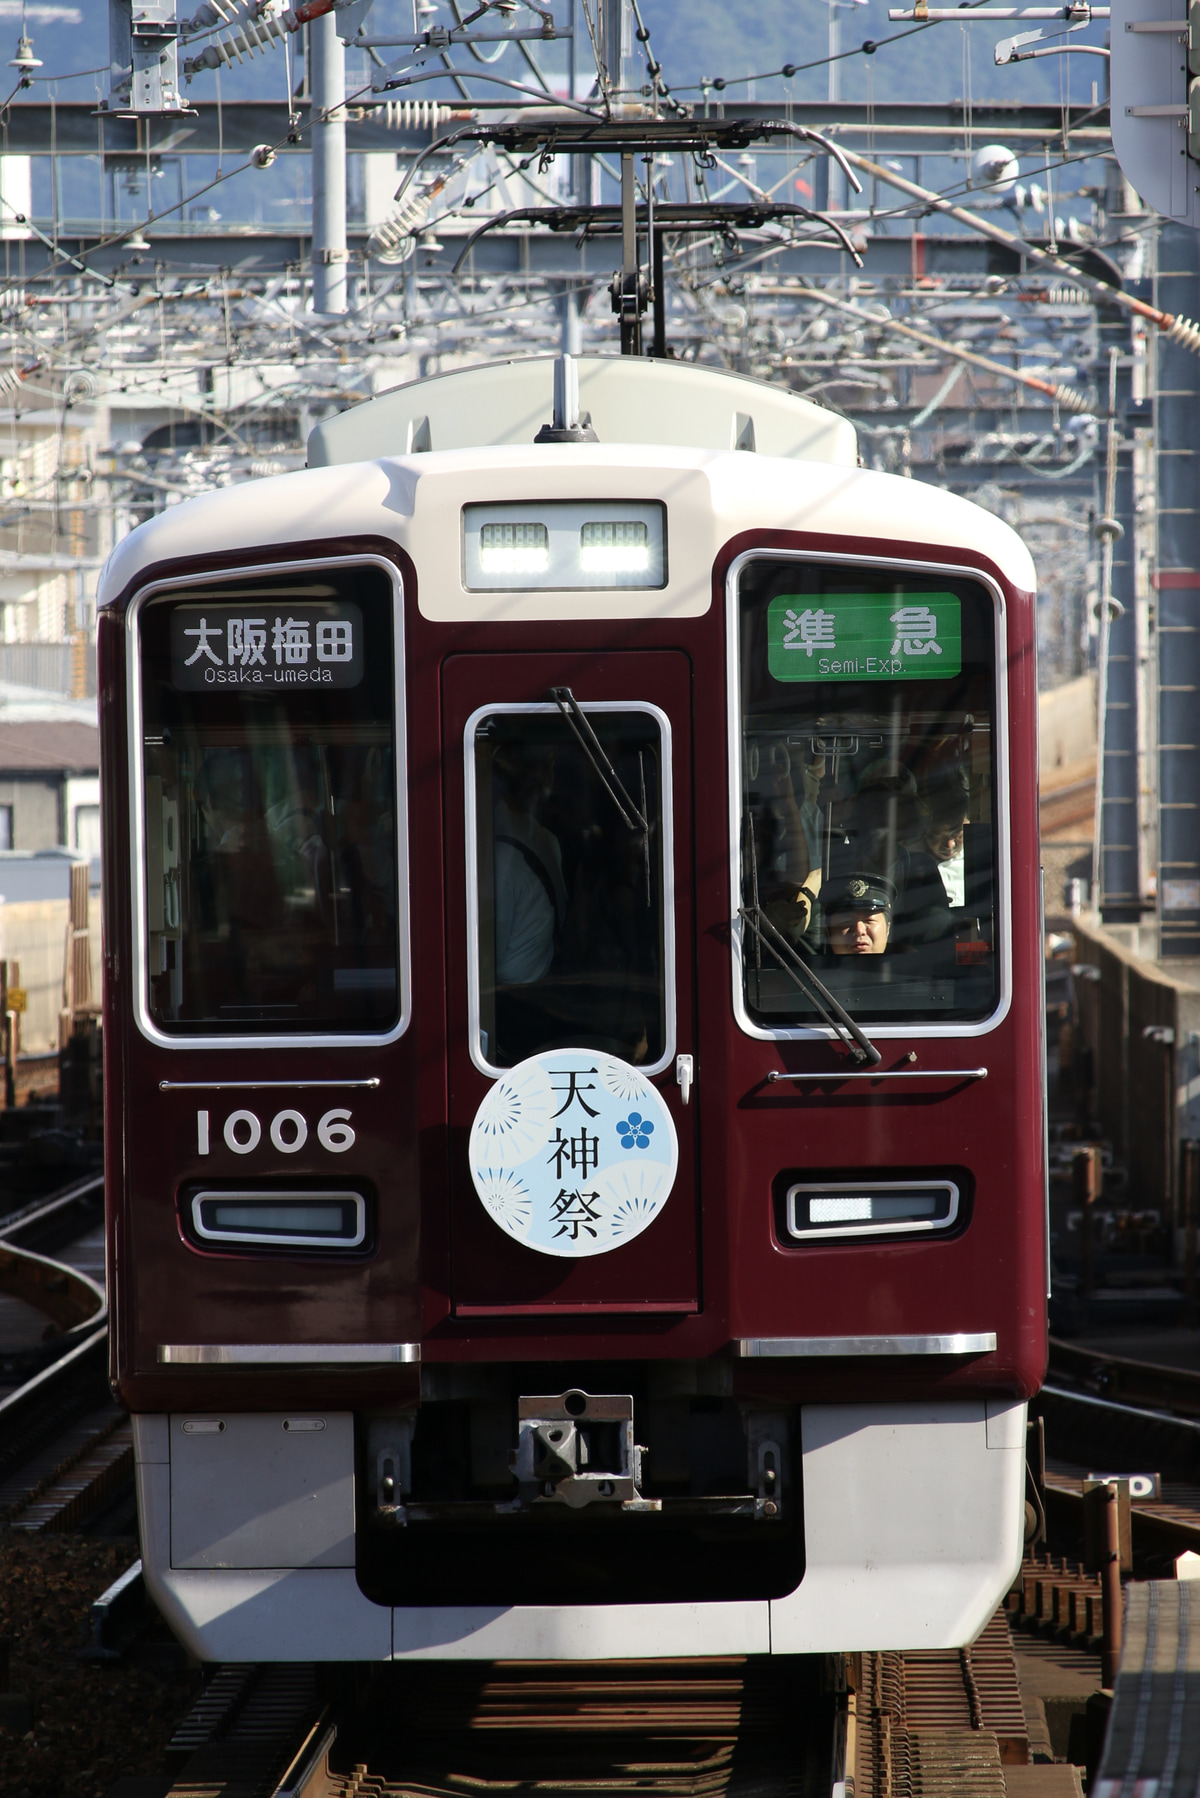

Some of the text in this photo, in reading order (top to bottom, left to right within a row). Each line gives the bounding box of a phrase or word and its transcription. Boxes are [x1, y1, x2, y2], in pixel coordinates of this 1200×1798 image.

[184, 617, 353, 666] 大阪梅田
[204, 667, 333, 683] Osaka-umeda
[818, 657, 907, 675] Semi-Exp.
[197, 1108, 356, 1155] 1006
[546, 1067, 602, 1240] 天神祭
